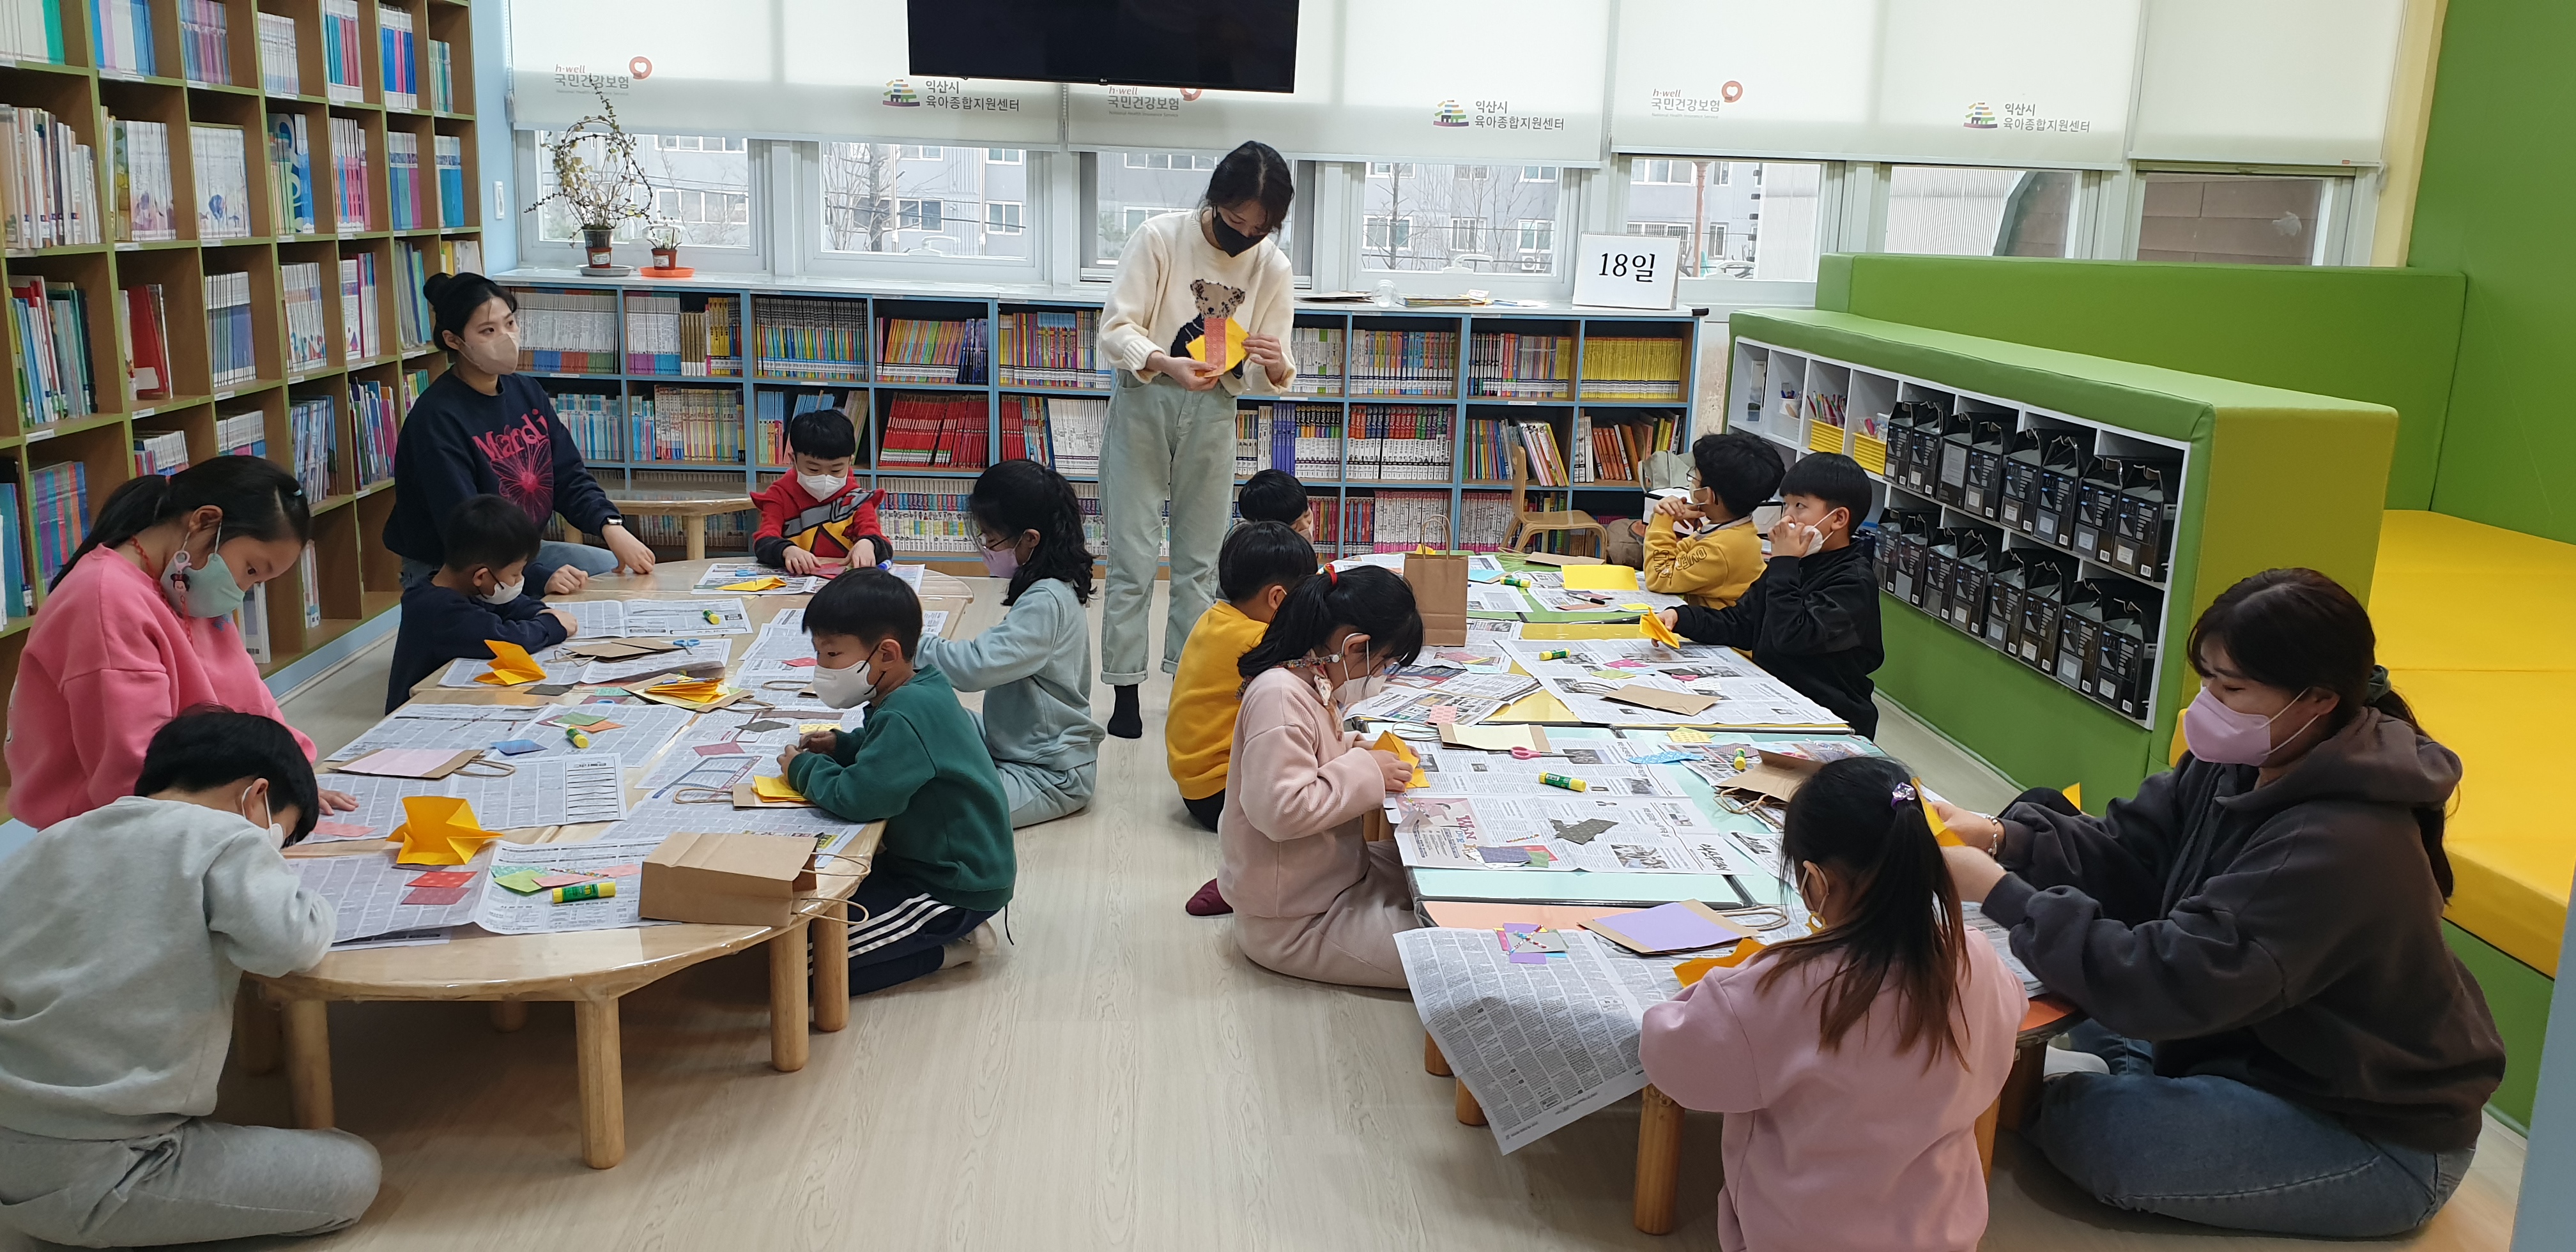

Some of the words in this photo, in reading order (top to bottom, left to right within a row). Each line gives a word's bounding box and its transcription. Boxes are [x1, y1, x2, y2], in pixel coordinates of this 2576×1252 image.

[555, 73, 629, 89] 국민건강보험
[926, 80, 960, 94] 익산시
[926, 95, 1020, 112] 육아종합지원센터
[1108, 96, 1179, 111] 국민건강보험
[1476, 100, 1507, 114] 익산시
[1652, 98, 1720, 112] 국민건강보험
[2005, 102, 2035, 116] 익산시
[1475, 115, 1564, 131] 육아종합지원센터
[2004, 117, 2090, 133] 육아종합지원센터
[1598, 253, 1655, 282] 18일
[471, 409, 548, 461] Mardi
